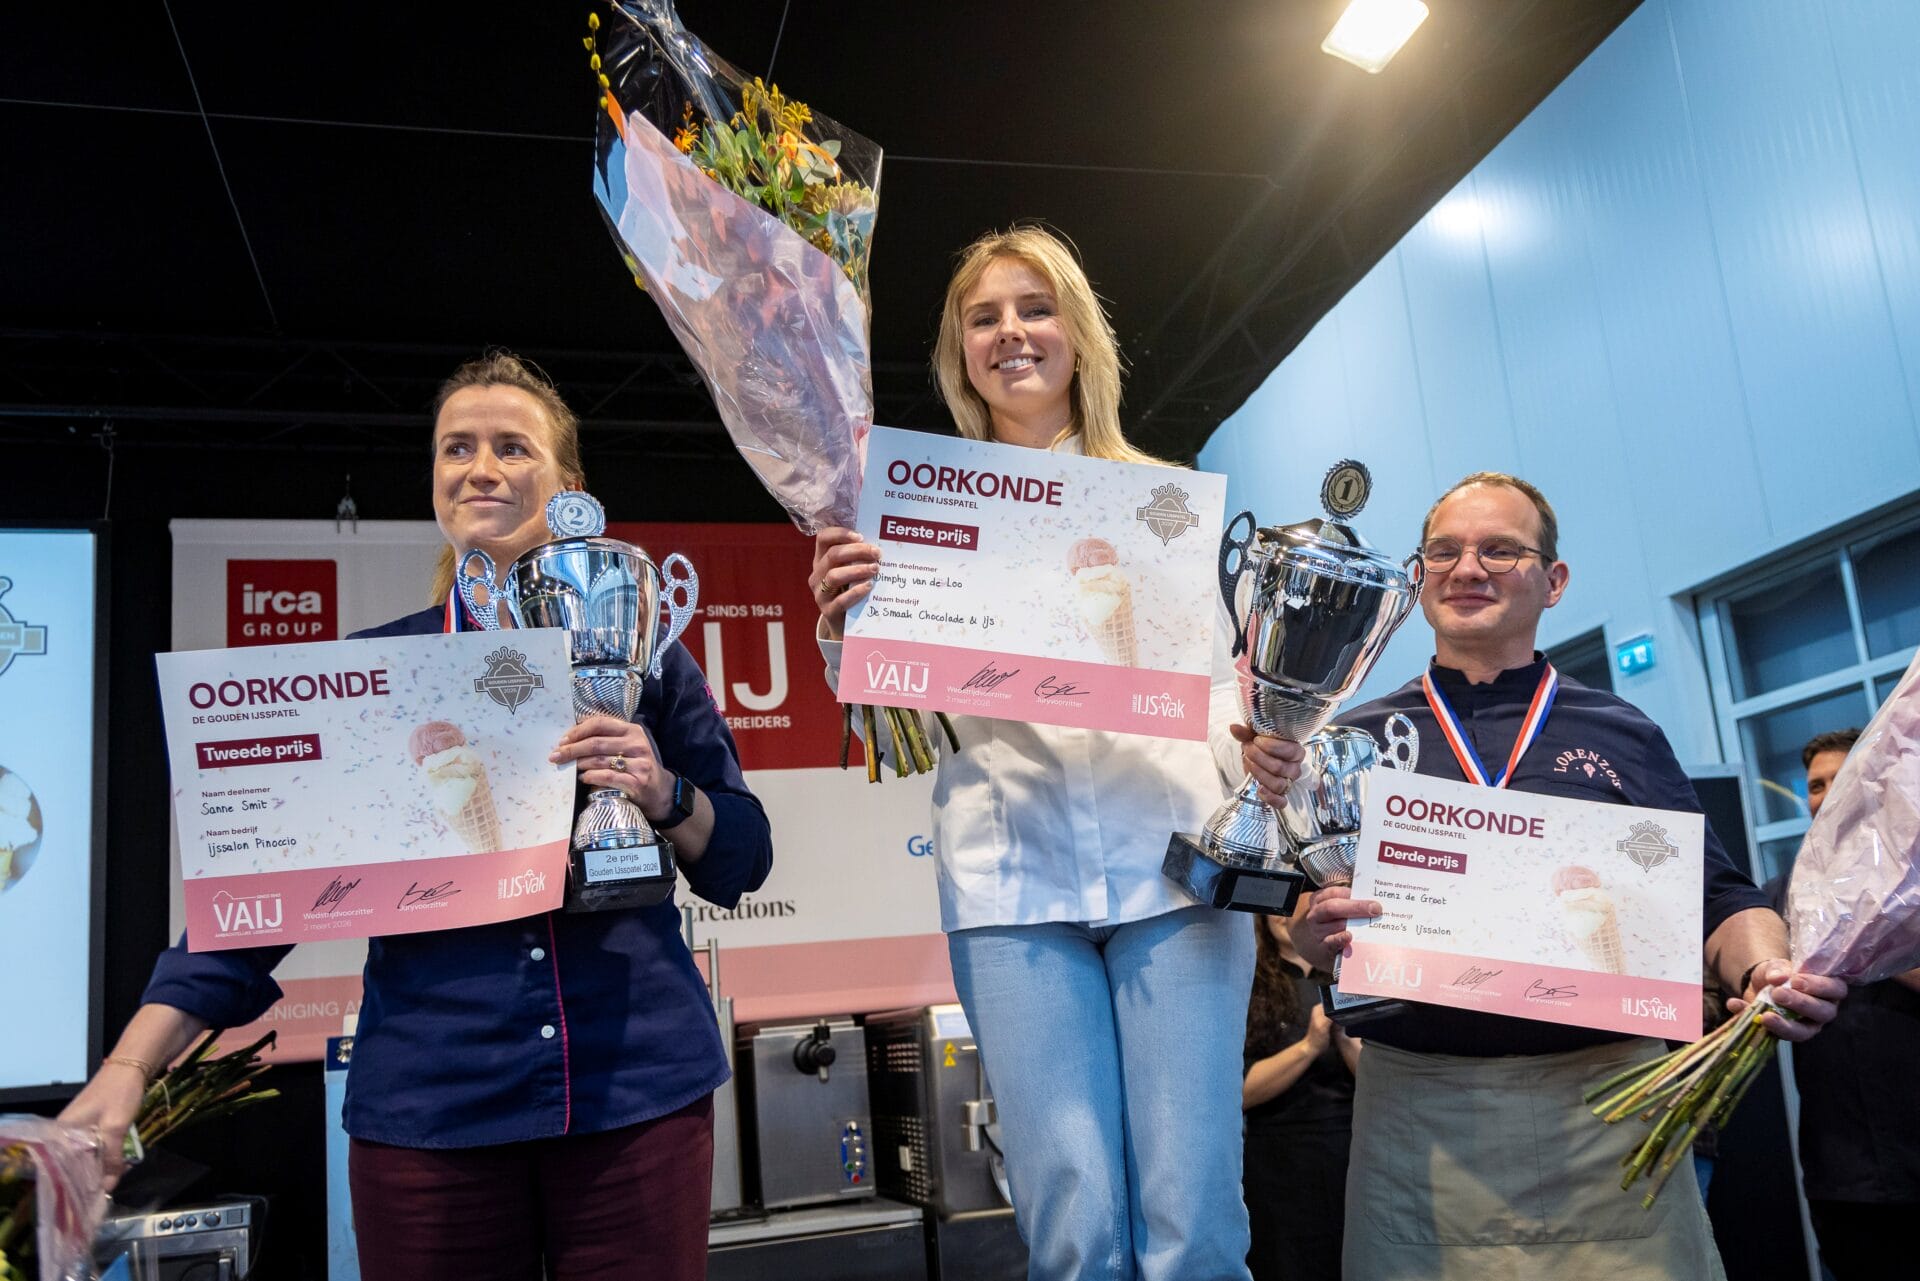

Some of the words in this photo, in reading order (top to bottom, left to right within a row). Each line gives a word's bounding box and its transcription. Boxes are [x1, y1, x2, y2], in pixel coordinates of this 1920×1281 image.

[887, 459, 1064, 507] OORKONDE
[1339, 478, 1354, 501] 1
[884, 489, 897, 498] DE
[897, 491, 935, 504] GOUDEN
[936, 497, 979, 510] IJSSPATEL
[568, 506, 584, 526] 2
[886, 520, 934, 539] Eerste
[937, 527, 971, 546] prijs
[876, 559, 898, 568] Naam
[898, 562, 938, 573] deelnemer
[912, 578, 927, 586] van
[929, 577, 941, 587] de
[946, 577, 963, 589] Loo
[243, 583, 322, 615] irca
[872, 595, 894, 603] Naam
[895, 597, 920, 607] bedrijf
[706, 604, 748, 617] SINDS
[750, 604, 784, 617] 1943
[867, 605, 880, 618] De
[919, 610, 965, 624] Chocolade
[0, 631, 16, 640] EN
[243, 622, 323, 637] GROUP
[703, 621, 789, 711] IJ
[866, 661, 930, 693] VAIJ
[189, 669, 390, 710] OORKONDE
[192, 716, 206, 725] DE
[207, 712, 250, 724] GOUDEN
[251, 708, 300, 720] IJSSPATEL
[726, 715, 792, 729] EREIDERS
[203, 744, 272, 762] Tweede
[275, 739, 314, 760] prijs
[202, 790, 226, 798] Naam
[227, 786, 271, 796] deelnemer
[201, 802, 234, 816] Sanne
[242, 800, 268, 812] Smit
[1385, 794, 1545, 839] OORKONDE
[206, 829, 230, 838] Naam
[231, 826, 258, 837] bedrijf
[1383, 819, 1394, 828] DE
[1394, 822, 1427, 834] GOUDEN
[1428, 828, 1467, 840] IJSSPATEL
[255, 835, 297, 849] Pinoccio
[605, 854, 617, 863] 2e
[620, 853, 639, 863] prijs
[1384, 845, 1426, 863] Derde
[1428, 853, 1459, 869] prijs
[588, 867, 614, 878] Gouden
[643, 862, 659, 872] 2026
[1374, 879, 1394, 887] Naam
[1394, 882, 1430, 892] deelnemer
[1374, 886, 1401, 900] Lorenz
[1405, 893, 1416, 901] de
[1420, 893, 1448, 905] Groot
[213, 899, 283, 932] VAIJ
[1364, 961, 1423, 988] VAIJ
